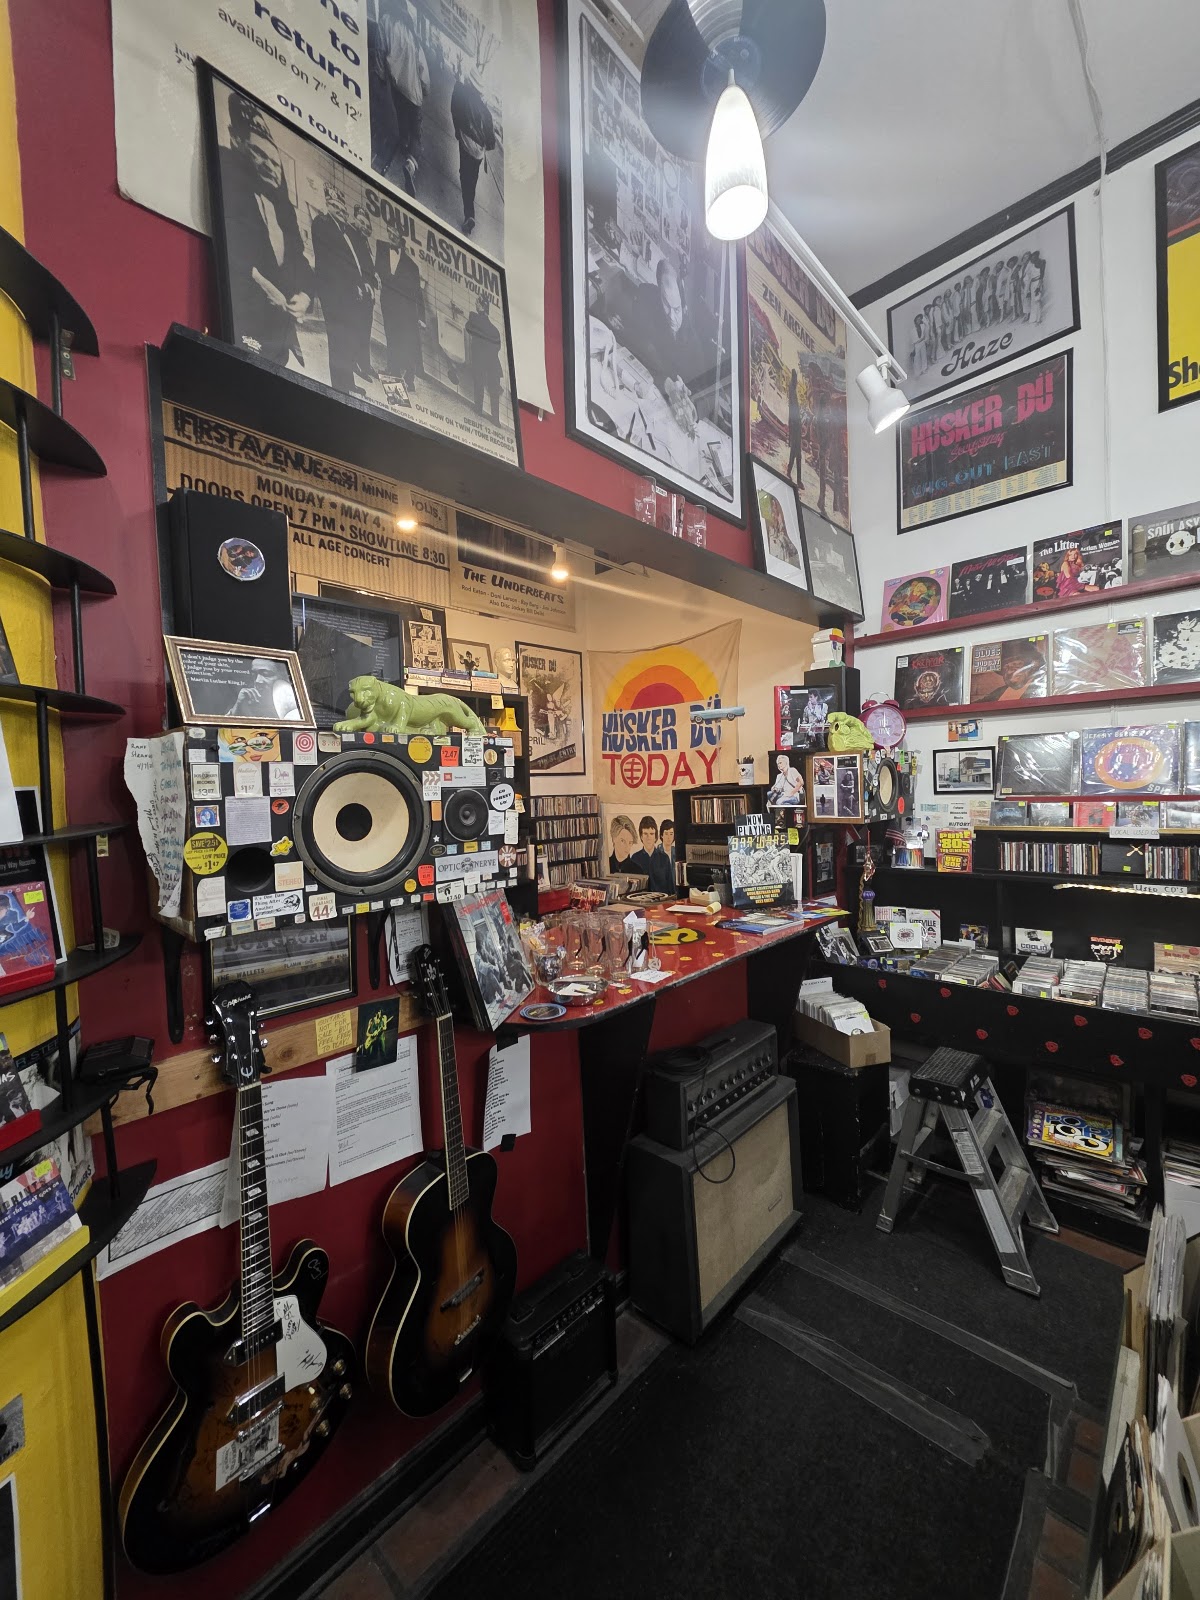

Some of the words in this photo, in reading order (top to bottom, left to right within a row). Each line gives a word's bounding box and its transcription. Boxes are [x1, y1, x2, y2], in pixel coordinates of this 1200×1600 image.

[218, 8, 287, 67] available
[291, 63, 309, 85] on
[330, 91, 340, 108] &
[254, 0, 362, 99] return
[329, 28, 361, 67] to
[277, 94, 303, 118] on
[365, 188, 423, 248] SOUL
[426, 229, 500, 298] ASYLUM
[419, 248, 436, 270] SAY
[437, 260, 462, 285] WHAT
[464, 279, 482, 299] YOU
[762, 283, 781, 316] ZEN
[783, 308, 816, 353] ARCADE
[940, 331, 1013, 377] Haze
[911, 394, 1004, 460] HÜSKER
[1012, 369, 1053, 425] DÜ
[415, 403, 429, 415] OUT
[429, 410, 446, 423] NOW
[445, 416, 455, 428] ON
[489, 436, 515, 453] RECORDS
[463, 416, 484, 432] DEBUT
[507, 436, 514, 445] EP
[173, 406, 238, 451] FIRST
[239, 431, 323, 481] AVENUE
[256, 475, 326, 509] MONDAY
[340, 502, 369, 525] MAY
[298, 508, 308, 524] 7
[312, 513, 336, 532] PM
[349, 524, 419, 558] SHOWTIME
[422, 546, 446, 566] 8:30
[1147, 523, 1175, 540] SOUL
[293, 531, 315, 548] ALL
[318, 538, 342, 554] AGE
[343, 544, 391, 569] CONCERT
[1039, 545, 1054, 557] The
[1053, 538, 1080, 553] Litter
[1080, 543, 1098, 552] Action
[462, 566, 487, 584] THE
[491, 574, 564, 604] UNDERBEATS
[521, 654, 546, 671] HÜSKER
[548, 658, 557, 672] DÜ
[602, 708, 678, 752] HÜSKER
[737, 823, 772, 836] PLAYING
[747, 814, 763, 826] NOW
[192, 840, 205, 848] SAVE
[939, 830, 971, 839] PURE
[438, 862, 460, 873] OPTIC
[473, 859, 497, 868] NERVE
[277, 876, 302, 886] STEREO
[236, 968, 265, 979] WALLETS
[221, 993, 252, 1009] Epiphone
[317, 1011, 346, 1026] GUITARS
[319, 1023, 331, 1031] NOT
[334, 1018, 347, 1028] FOR
[318, 1036, 334, 1047] FEEL
[336, 1031, 351, 1041] FREE
[22, 1194, 39, 1208] BEAT
[38, 1186, 52, 1198] GOES
